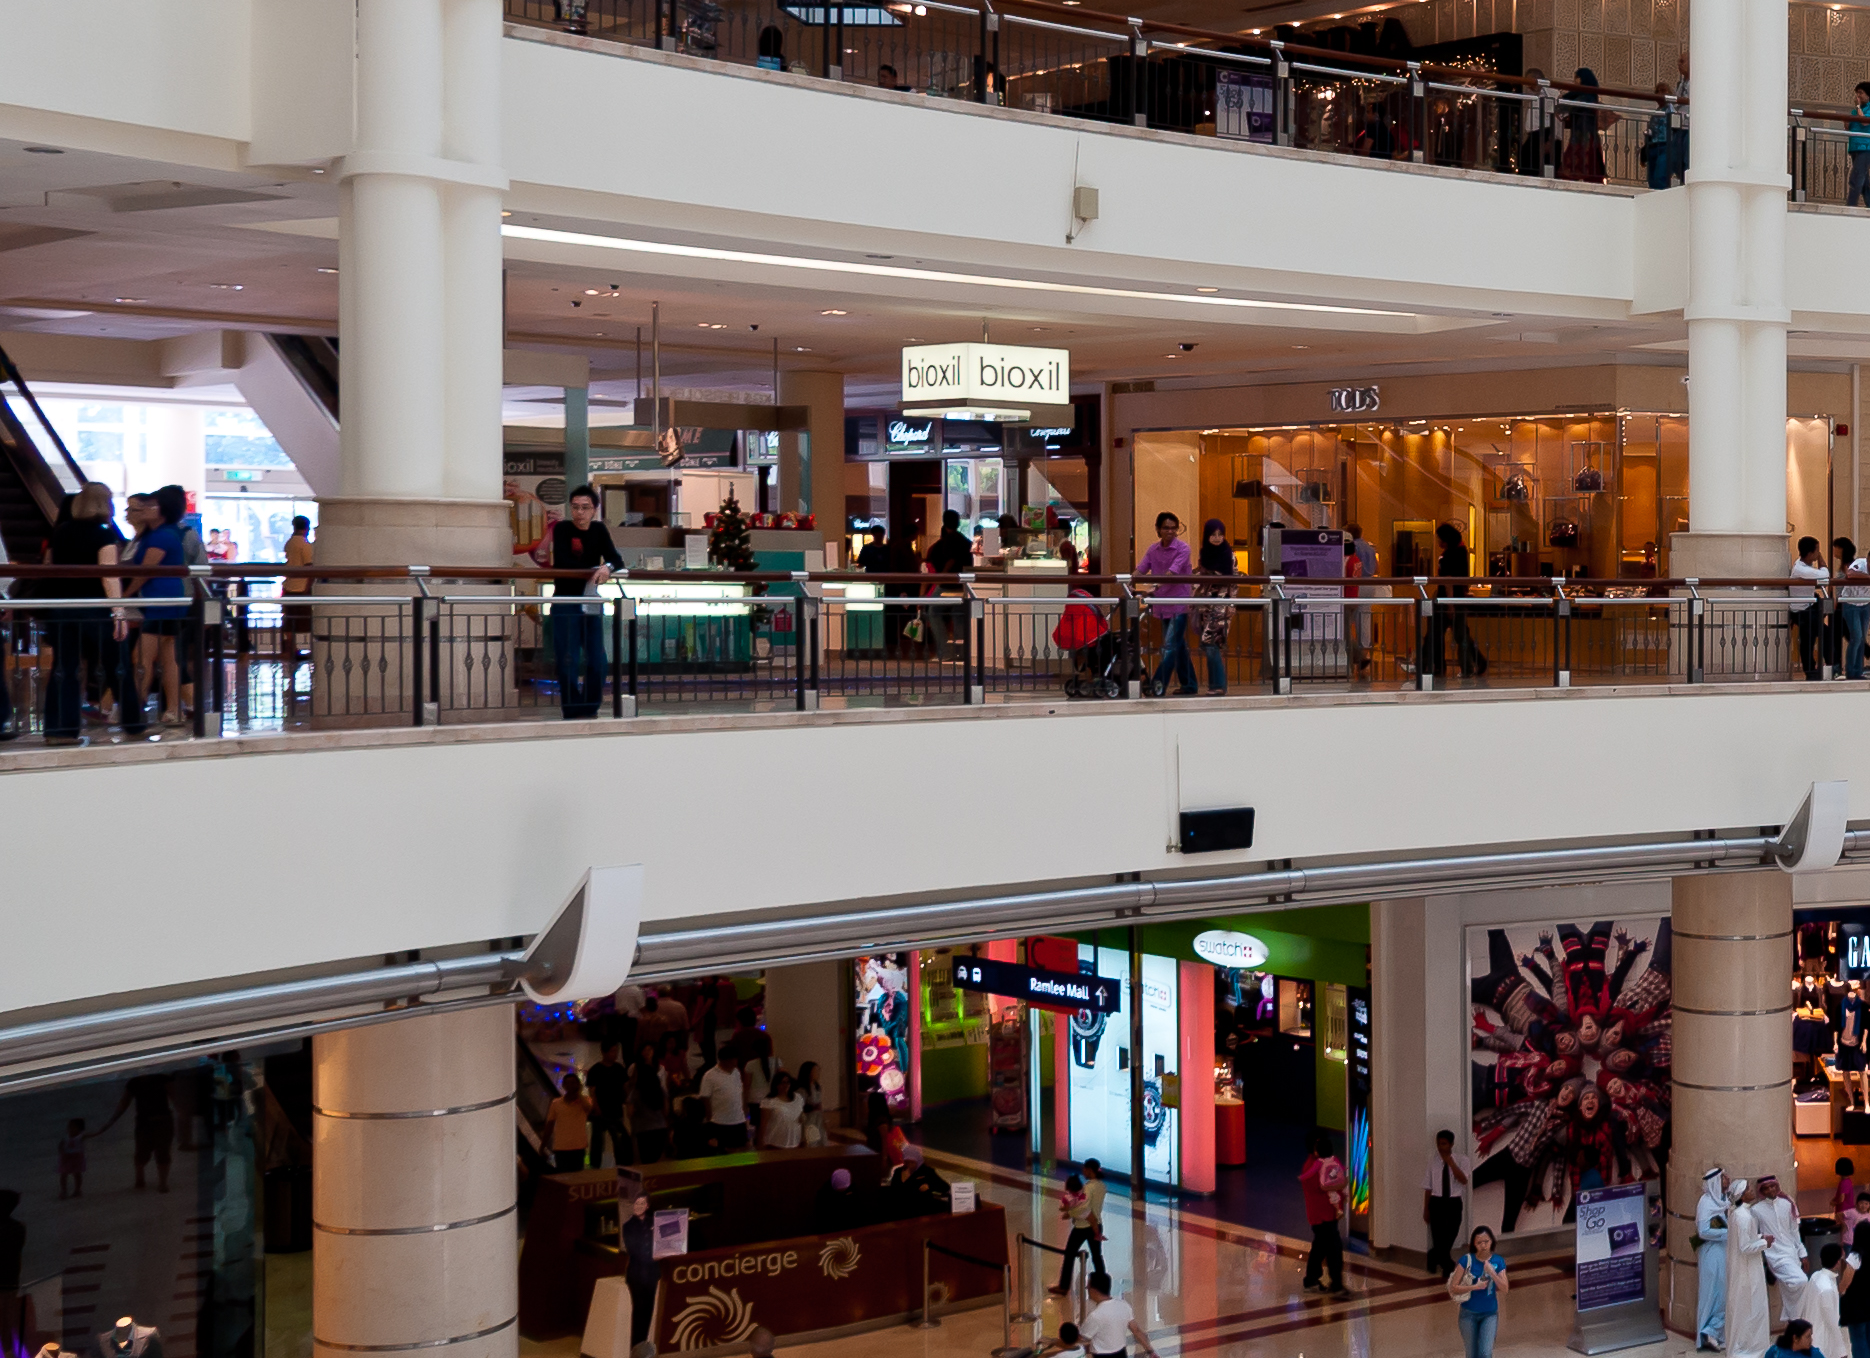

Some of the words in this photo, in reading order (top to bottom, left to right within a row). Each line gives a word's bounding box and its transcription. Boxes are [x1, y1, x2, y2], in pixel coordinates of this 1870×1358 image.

[908, 355, 962, 389] bioxil
[980, 356, 1061, 392] bioxil
[1199, 939, 1244, 958] swatch
[1030, 977, 1065, 997] Ramlee
[1067, 983, 1090, 1002] Mall
[672, 1250, 798, 1285] concierge
